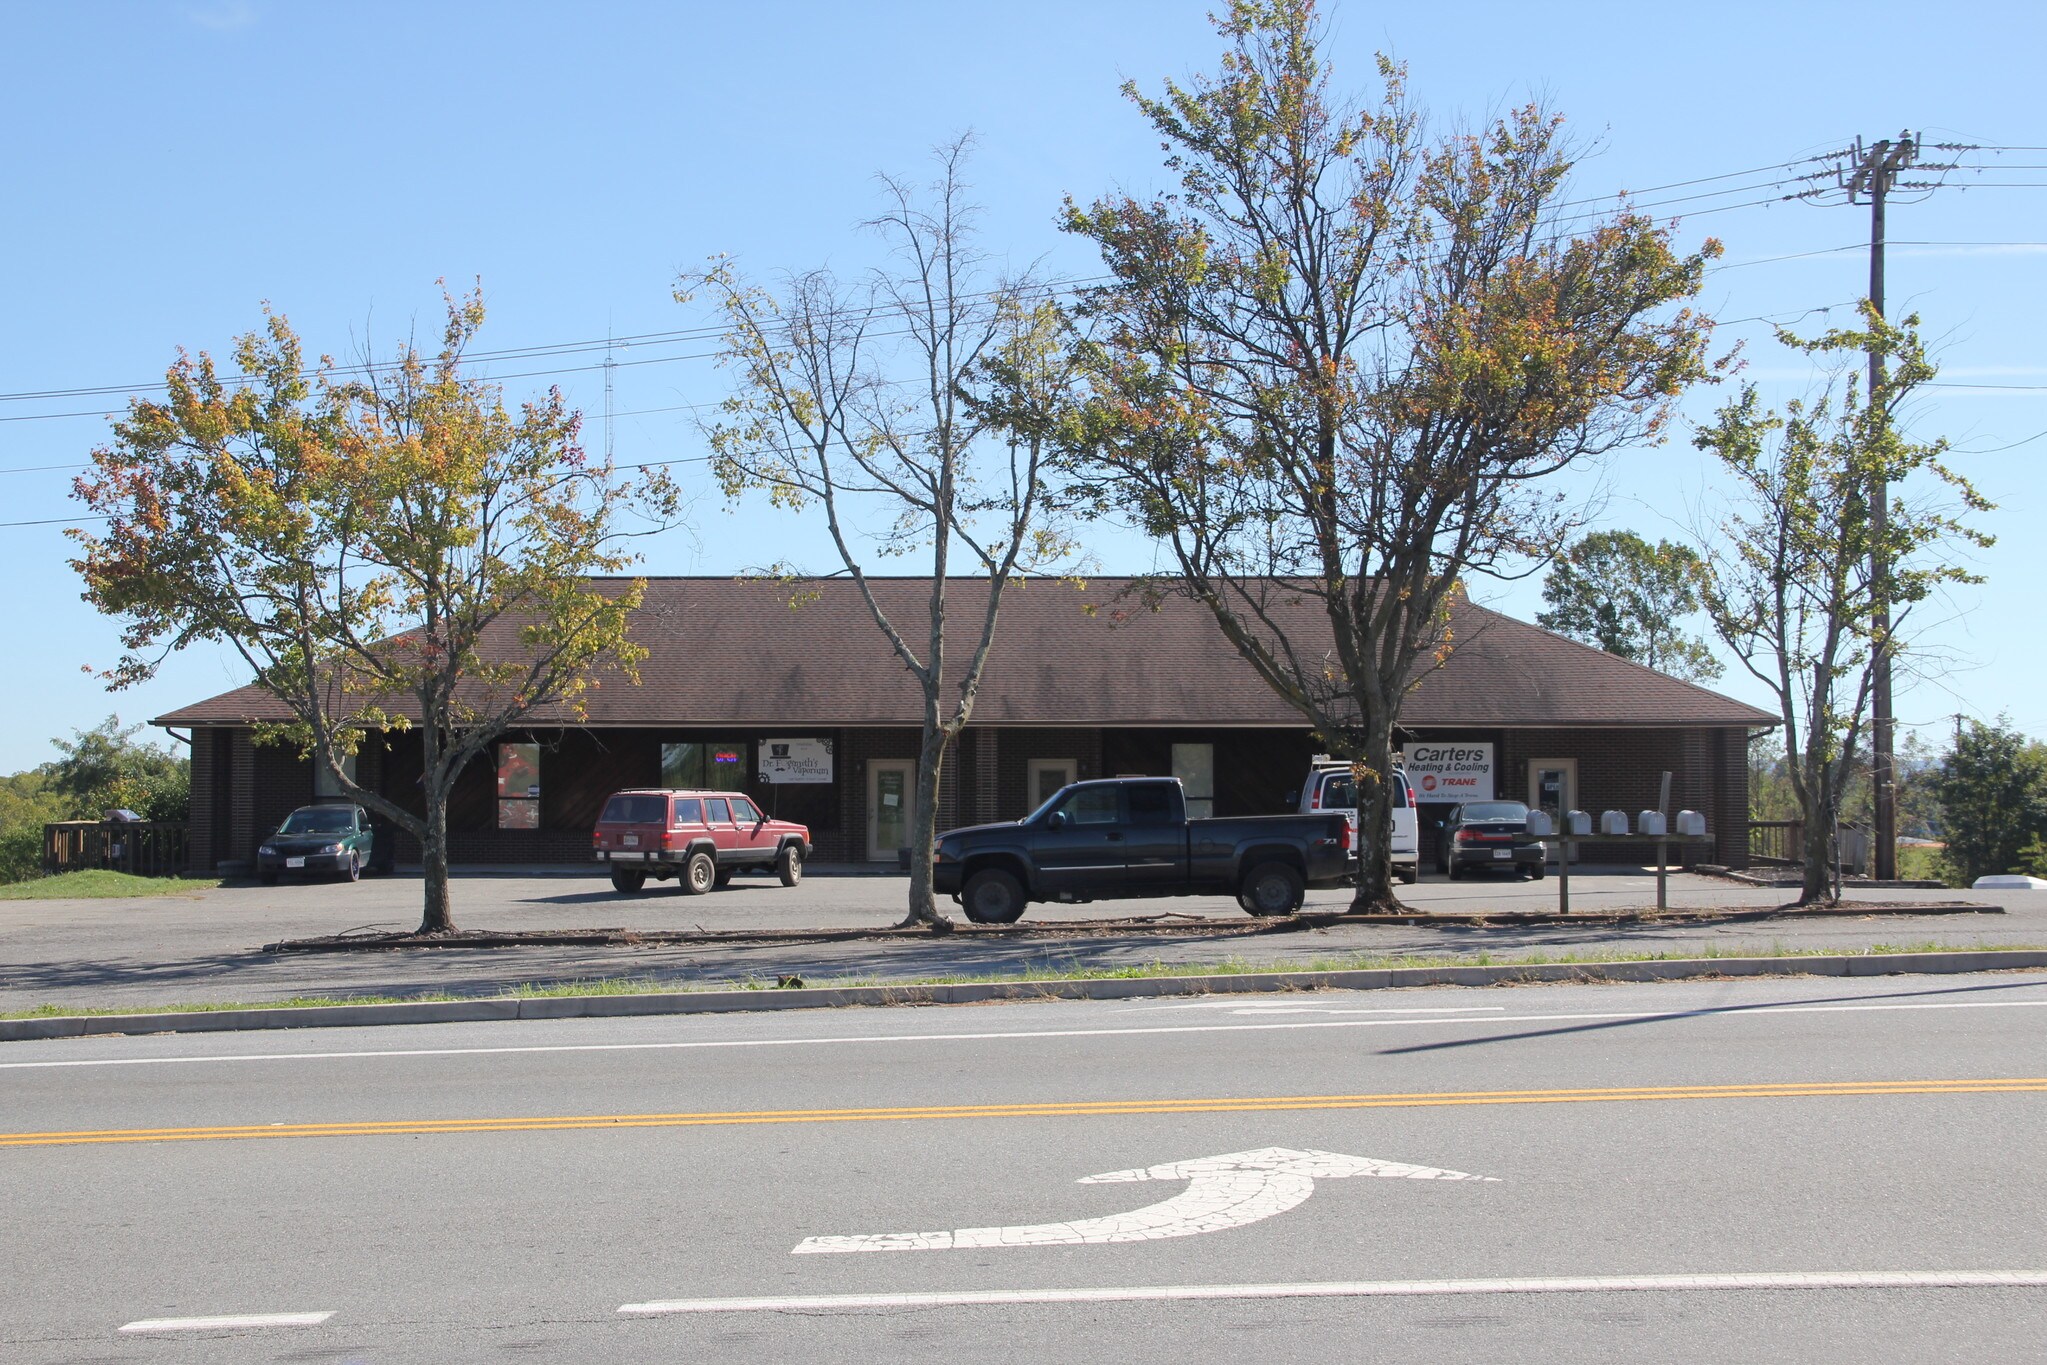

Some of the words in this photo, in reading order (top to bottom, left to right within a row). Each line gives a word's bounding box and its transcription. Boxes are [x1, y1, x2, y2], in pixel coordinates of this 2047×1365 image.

[1414, 747, 1484, 761] Carters
[793, 767, 828, 776] Vaporium
[1408, 762, 1443, 773] Heating
[1445, 763, 1453, 771] &
[1454, 762, 1489, 773] Cooling
[1441, 778, 1477, 786] TRANE
